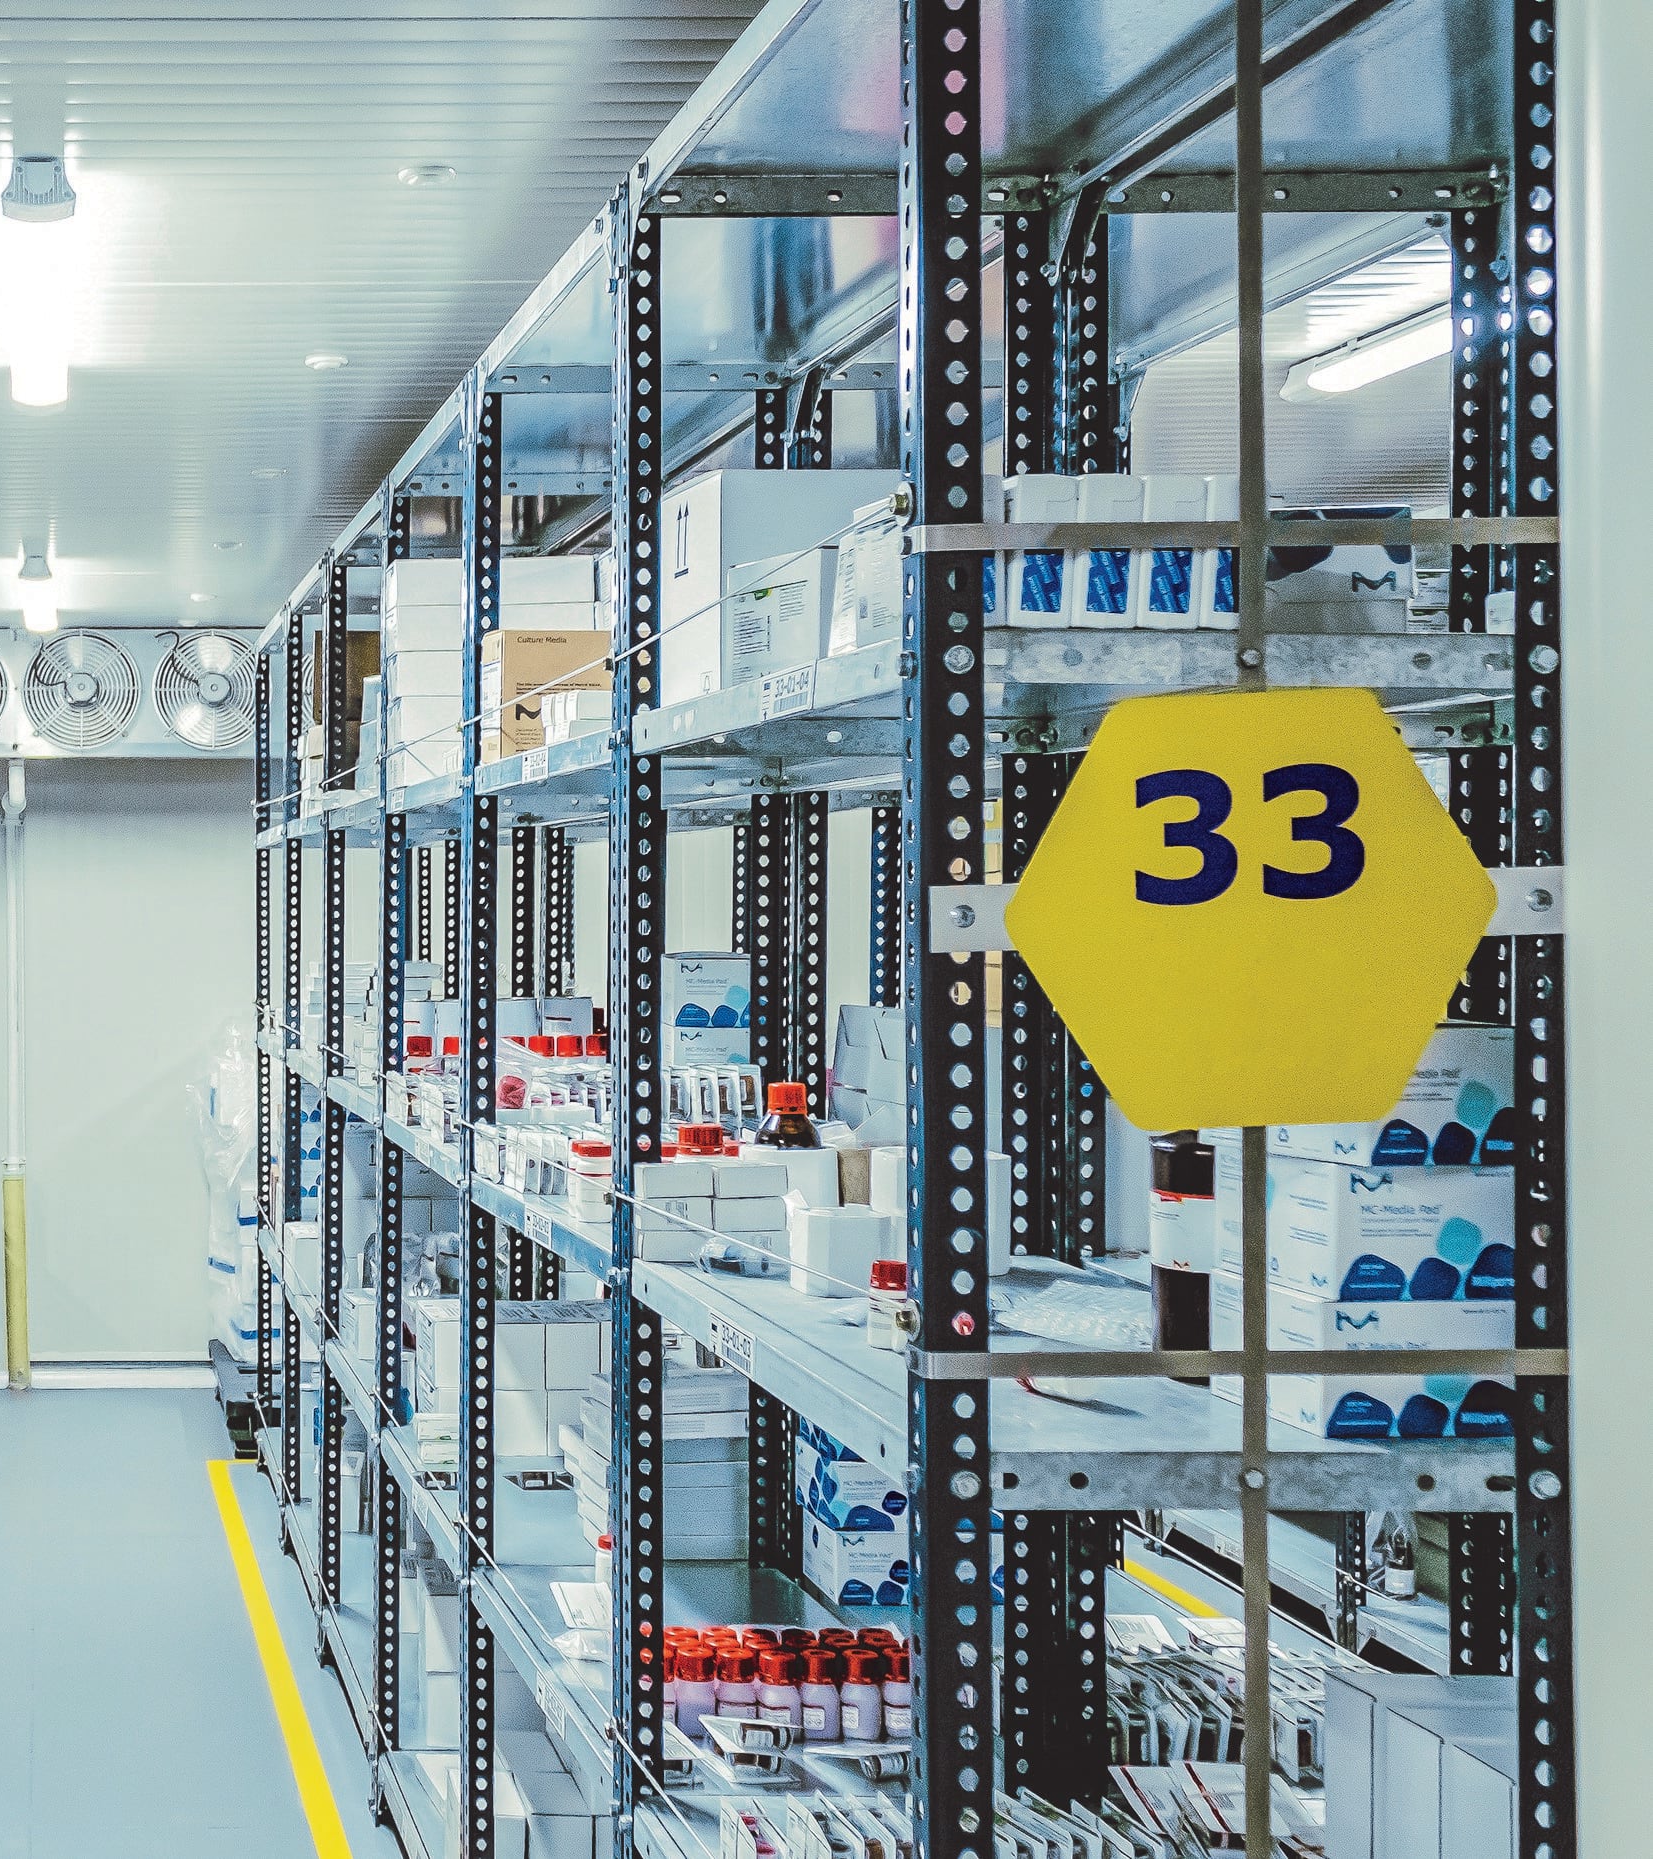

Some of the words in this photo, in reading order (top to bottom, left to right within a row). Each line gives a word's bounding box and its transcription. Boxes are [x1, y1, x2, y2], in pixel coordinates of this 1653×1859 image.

[517, 636, 544, 644] Culture
[545, 636, 567, 644] Media
[1134, 762, 1366, 906] 33
